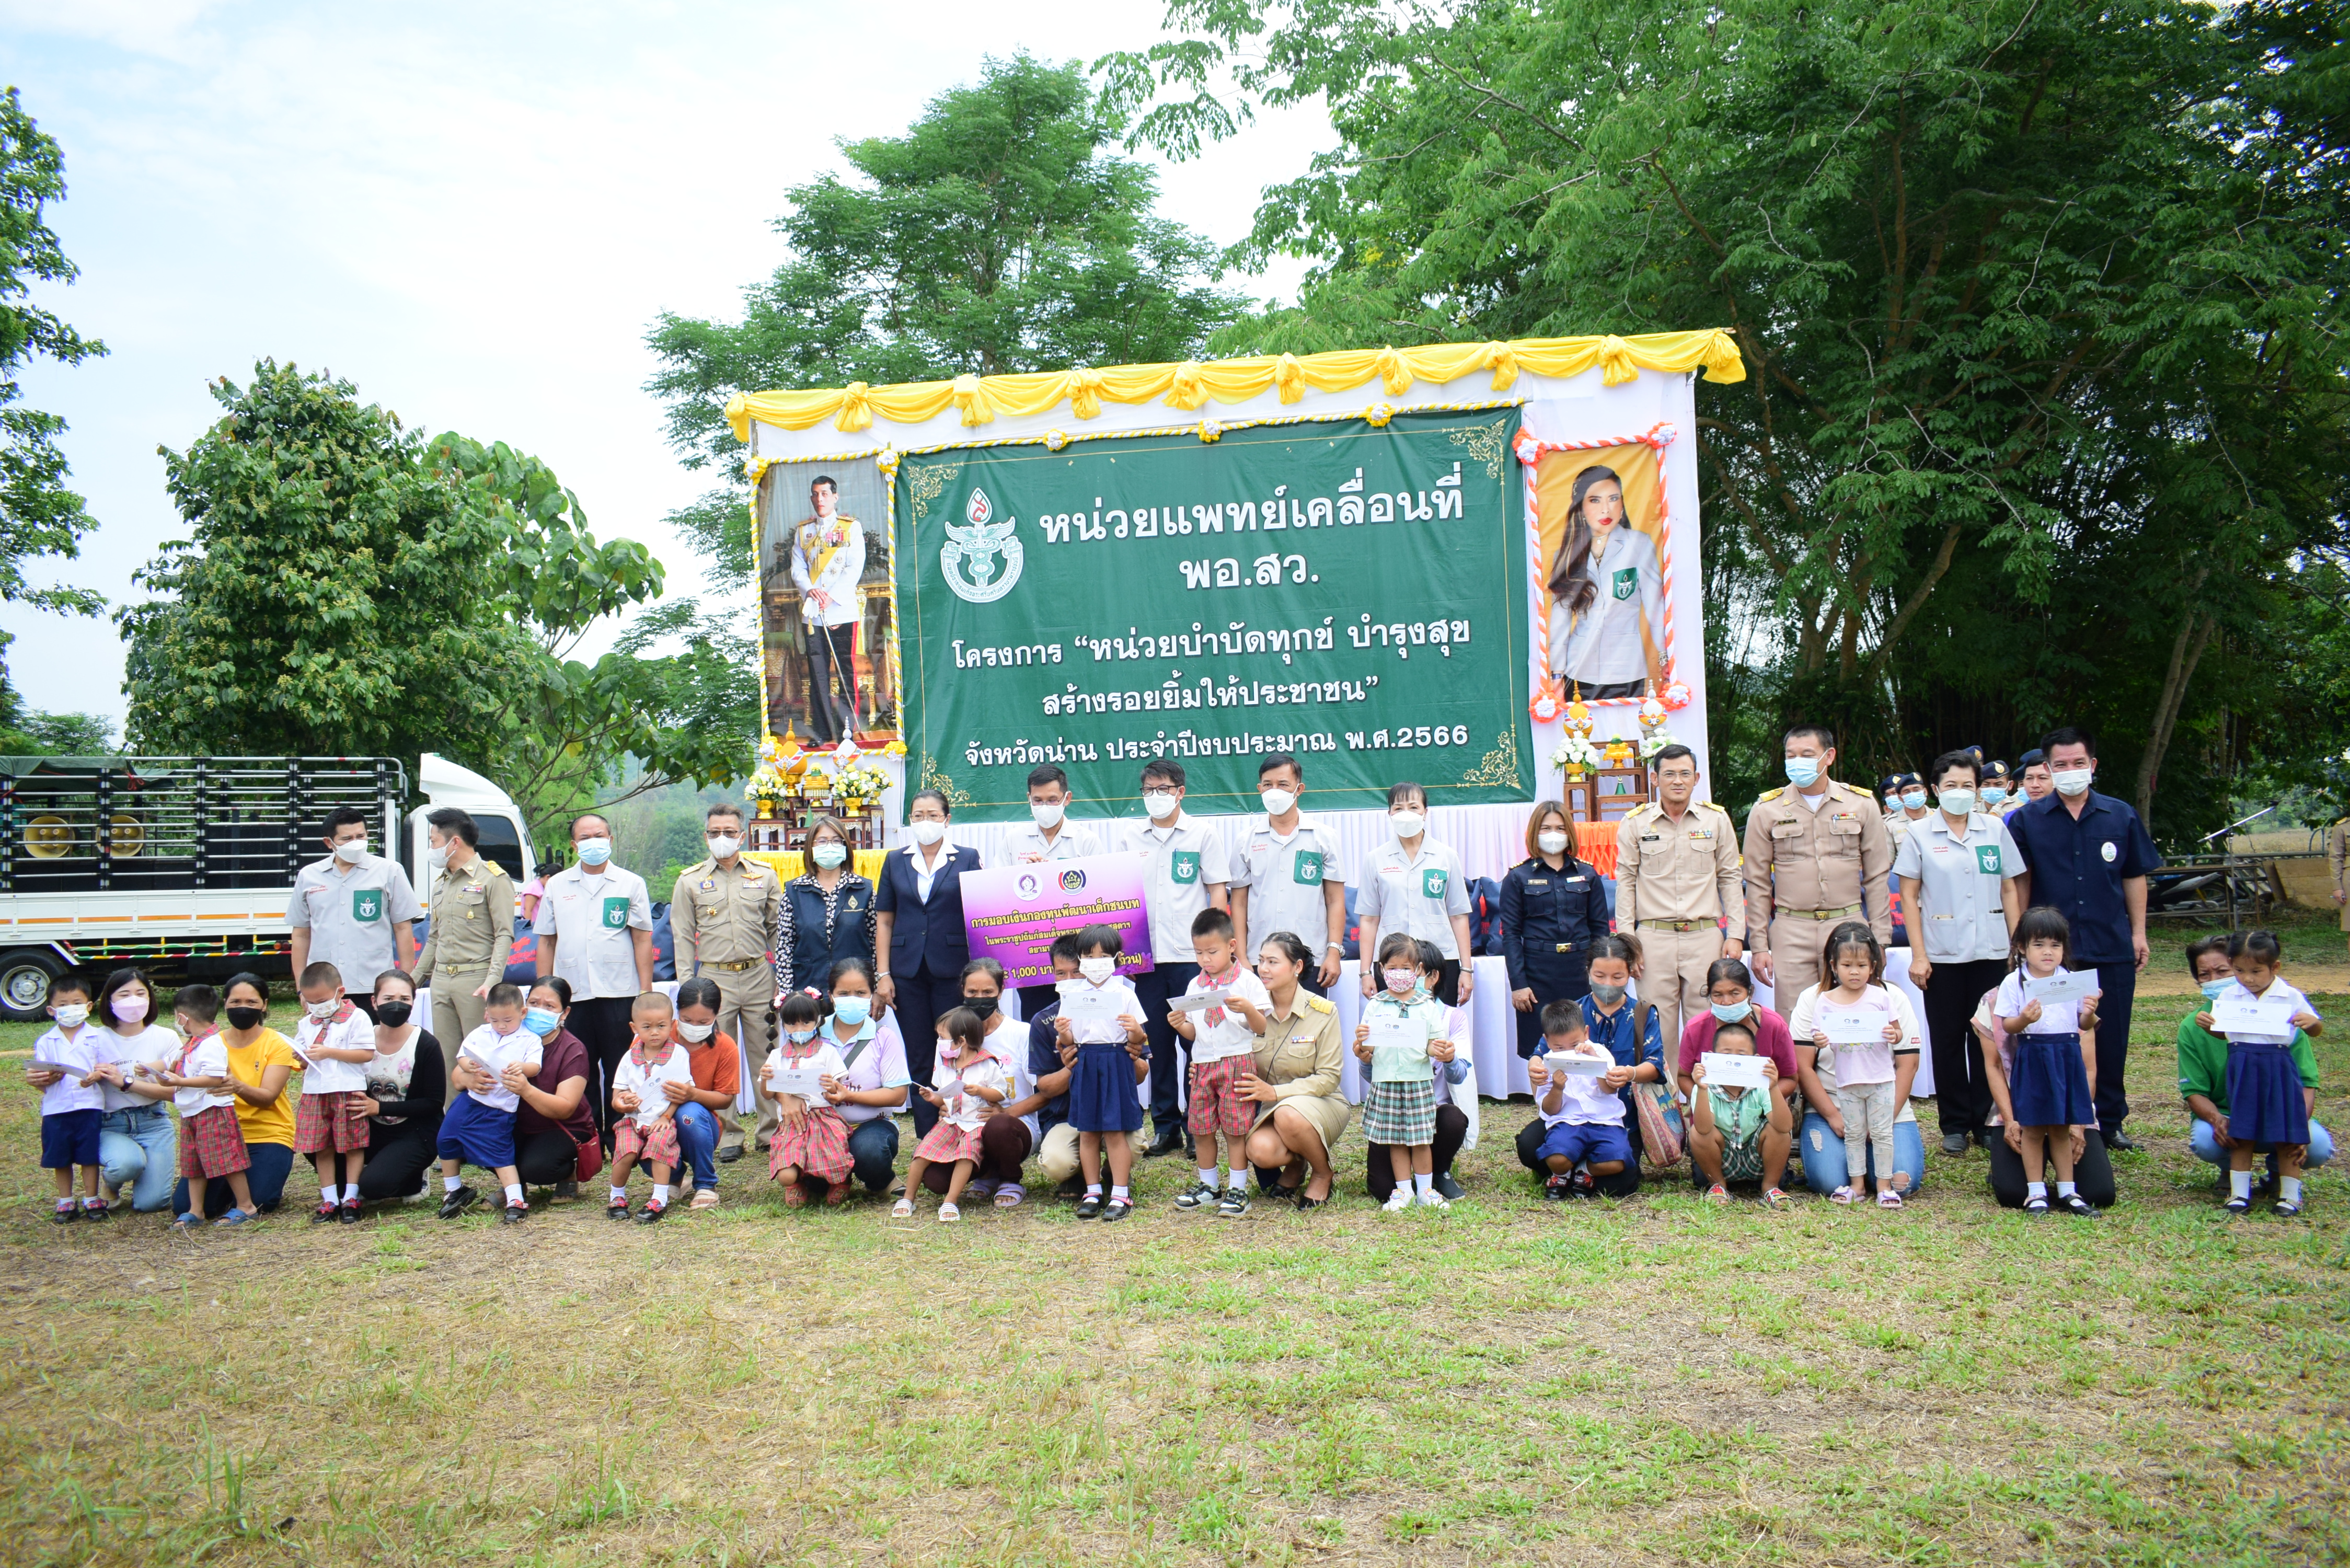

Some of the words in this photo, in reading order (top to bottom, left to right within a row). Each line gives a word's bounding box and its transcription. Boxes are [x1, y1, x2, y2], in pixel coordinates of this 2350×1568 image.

[1039, 462, 1463, 544] หน่วยแพทย์เคลื่อนที่
[1179, 552, 1319, 589] พอ.สว.
[952, 640, 1062, 668] โครงการ
[1075, 616, 1333, 665] “หน่วยบำบัดทุกข์
[1347, 613, 1470, 659] บำรุงสุข
[1042, 670, 1378, 715] สร้างรอยยิ้มให้ประชาชน”
[965, 736, 1098, 766] จังหวัดน่าน
[1106, 729, 1336, 760] ประจำปีงบประมาณ
[1345, 724, 1468, 750] พ.ศ.2566
[971, 897, 1140, 928] การมอบเงินกองทุนพัฒนาเด็กชนบท
[1011, 966, 1036, 979] 1,000
[1039, 965, 1053, 974] บา
